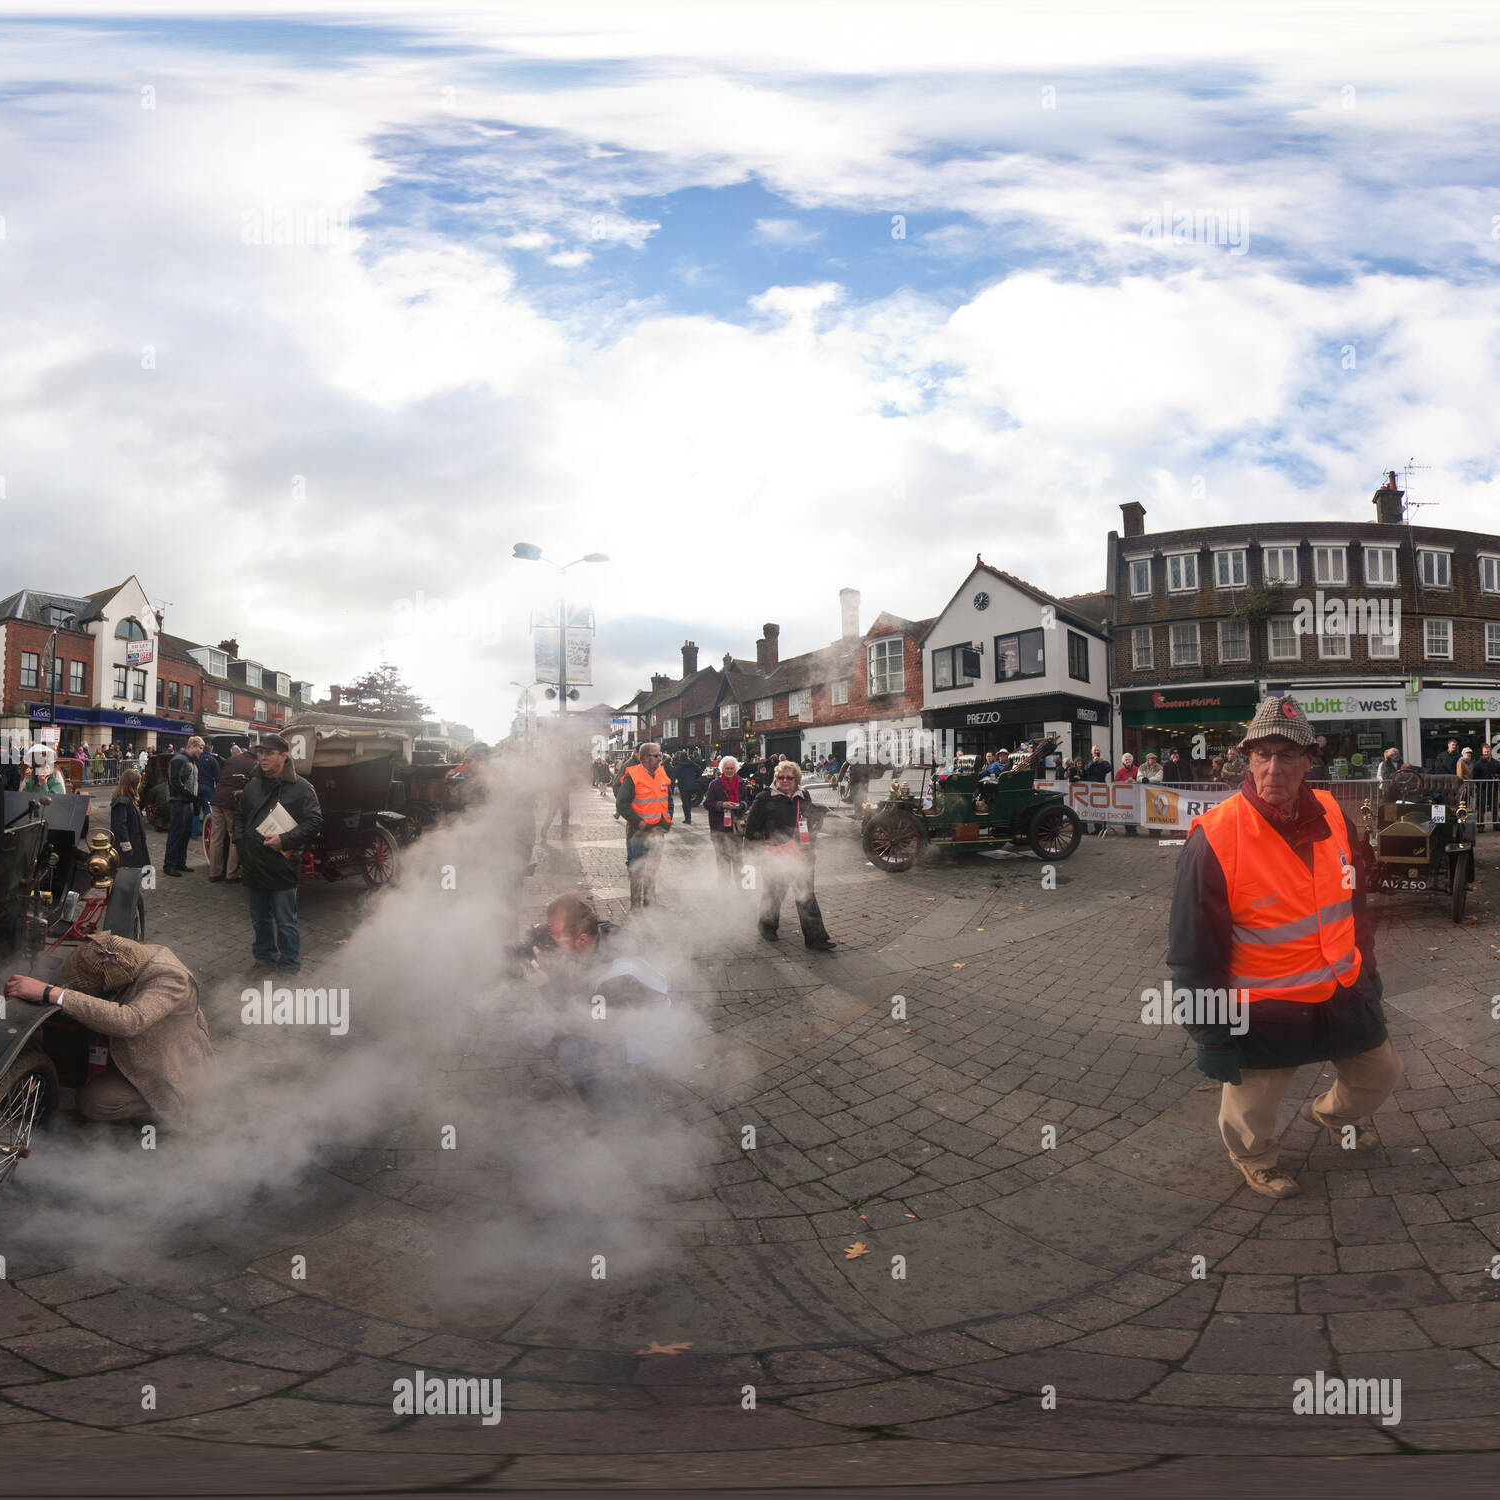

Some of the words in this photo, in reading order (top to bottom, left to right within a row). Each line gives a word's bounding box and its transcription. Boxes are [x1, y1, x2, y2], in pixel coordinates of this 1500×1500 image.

[1359, 698, 1398, 712] west
[1444, 696, 1485, 712] cubitt
[966, 712, 1001, 725] PREZZO
[1082, 811, 1106, 820] driving
[1108, 812, 1134, 820] people
[1148, 816, 1177, 824] RENAULT
[1402, 880, 1426, 890] 250
